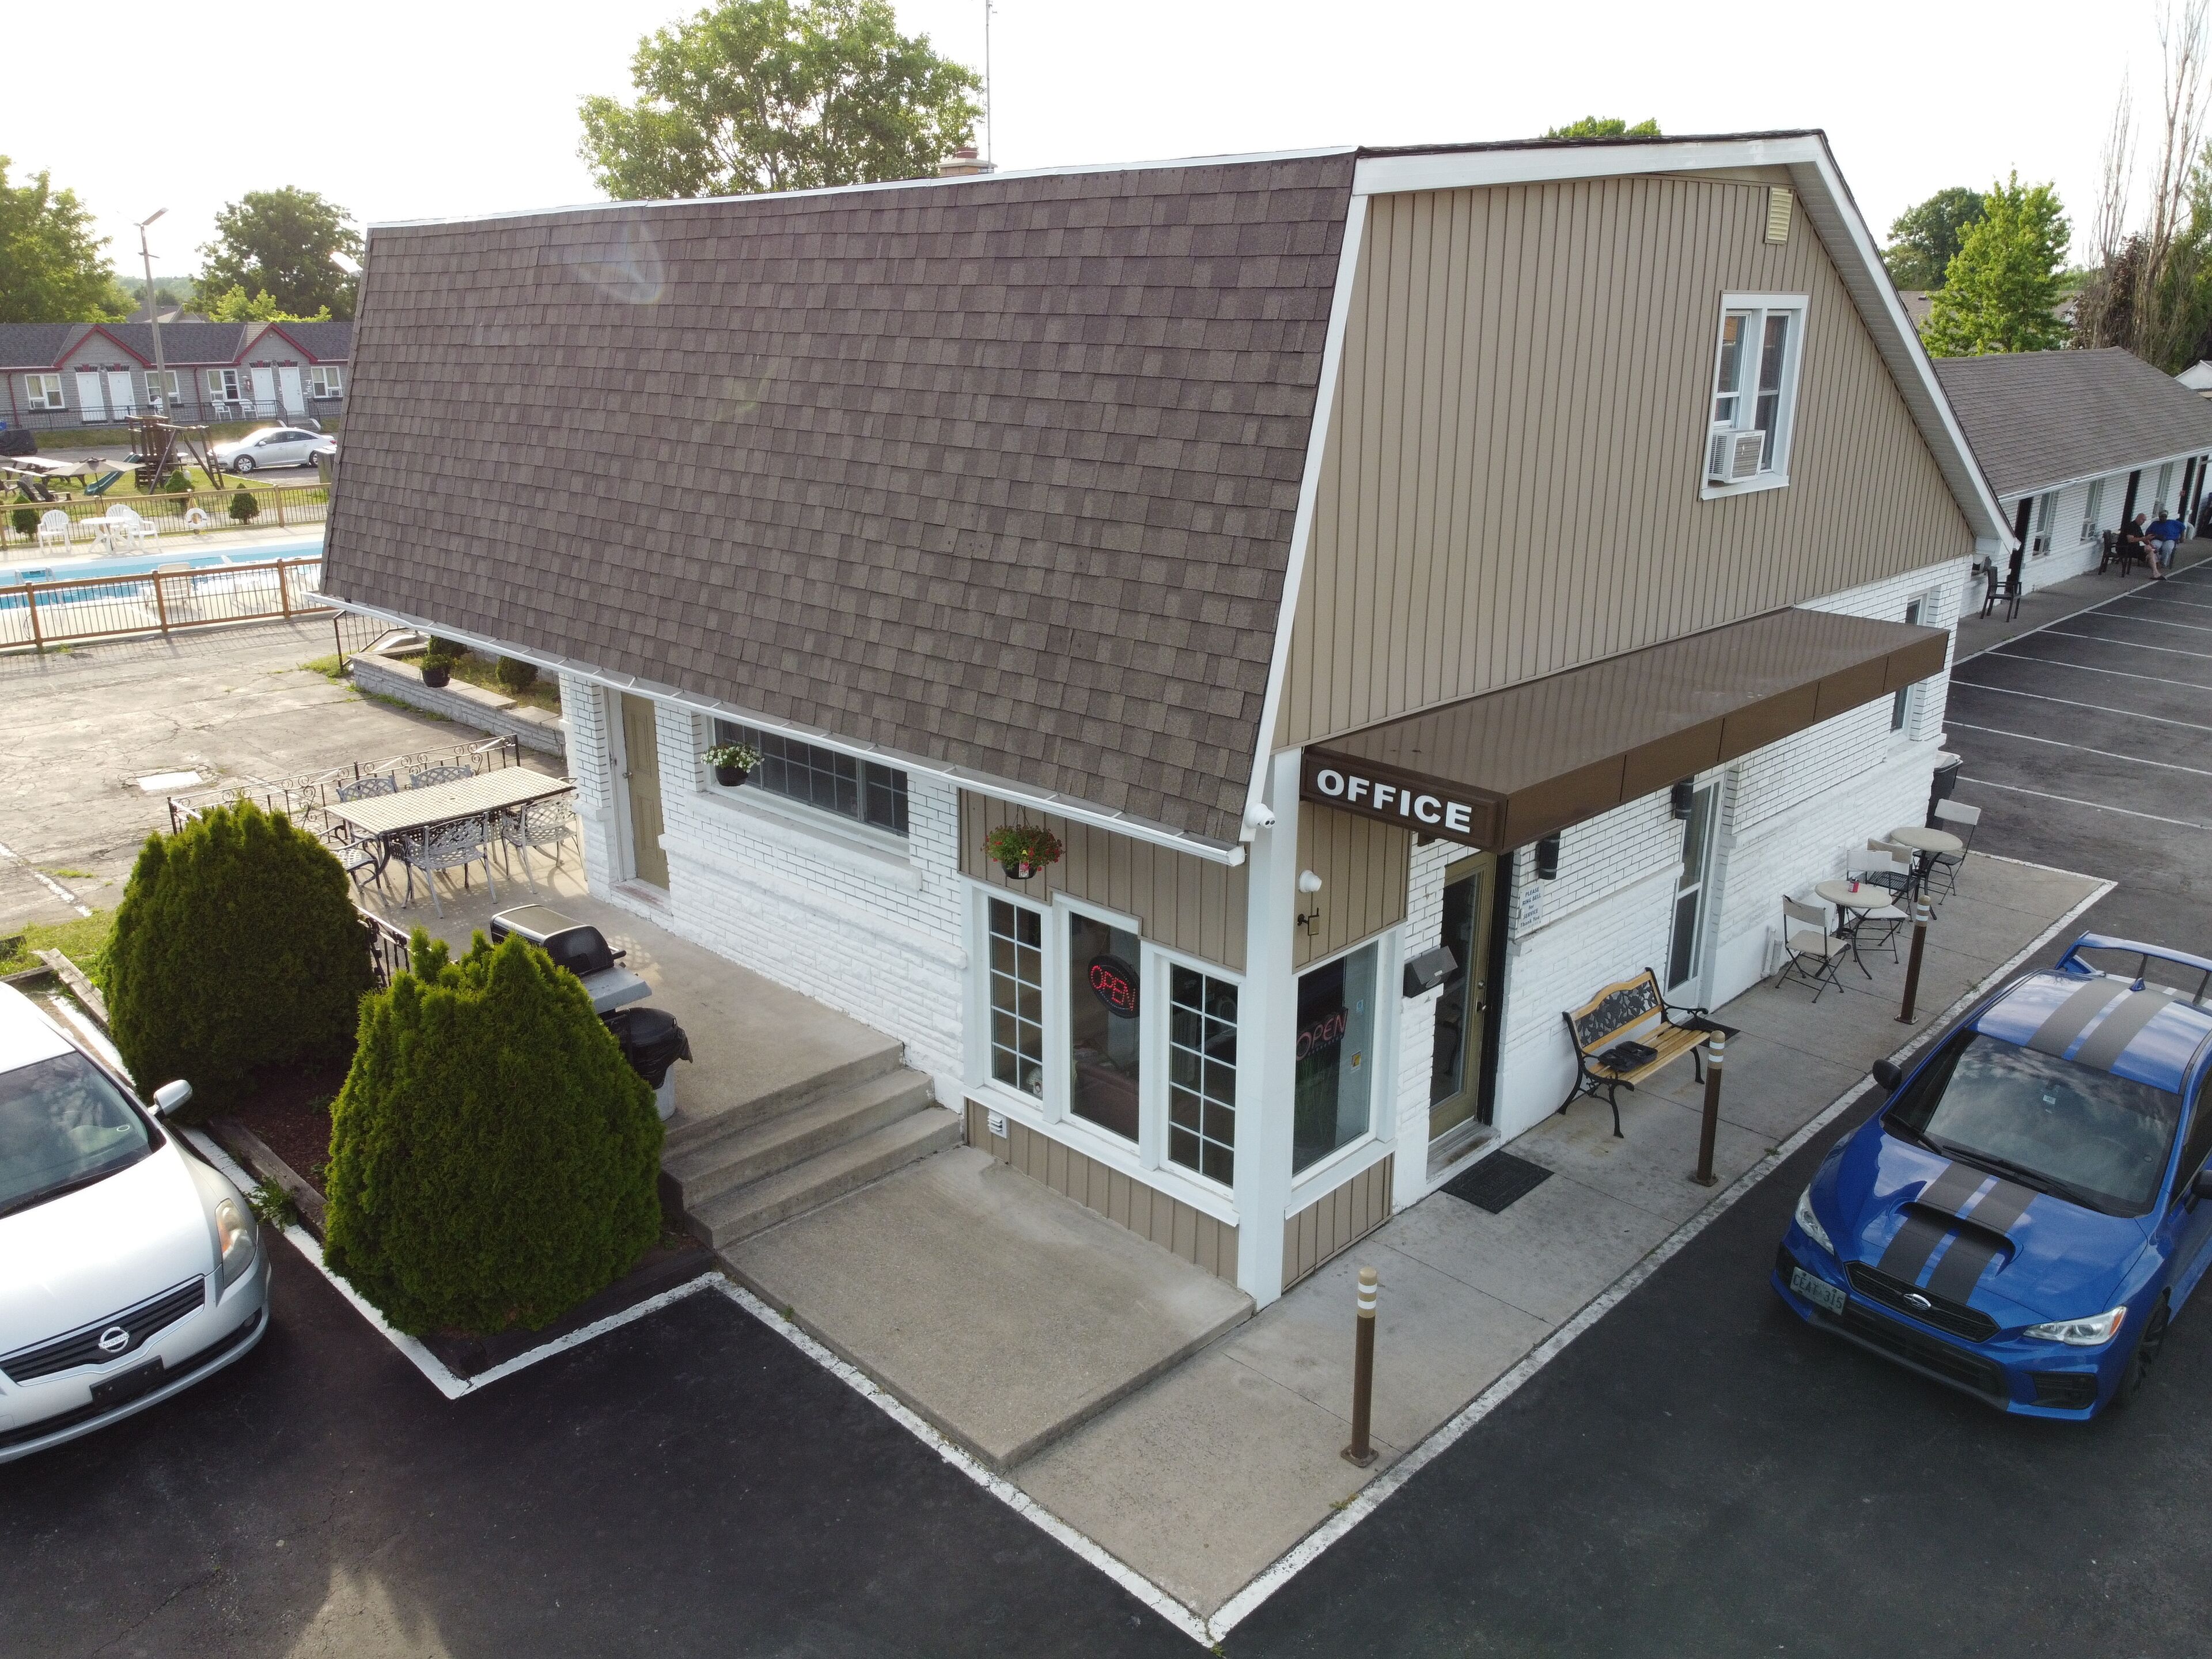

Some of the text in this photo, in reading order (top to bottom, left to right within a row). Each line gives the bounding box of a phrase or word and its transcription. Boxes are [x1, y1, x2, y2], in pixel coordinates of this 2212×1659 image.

[1317, 769, 1472, 834] OFFICE
[1525, 887, 1540, 897] PLEASE
[1532, 893, 1541, 902] BELL
[1523, 908, 1539, 920] SERVICE
[1520, 918, 1532, 928] Thank
[1090, 964, 1136, 1012] OPEN
[1296, 1009, 1347, 1061] OPEN
[1823, 1290, 1843, 1309] 315
[103, 1333, 128, 1347] NISSAN
